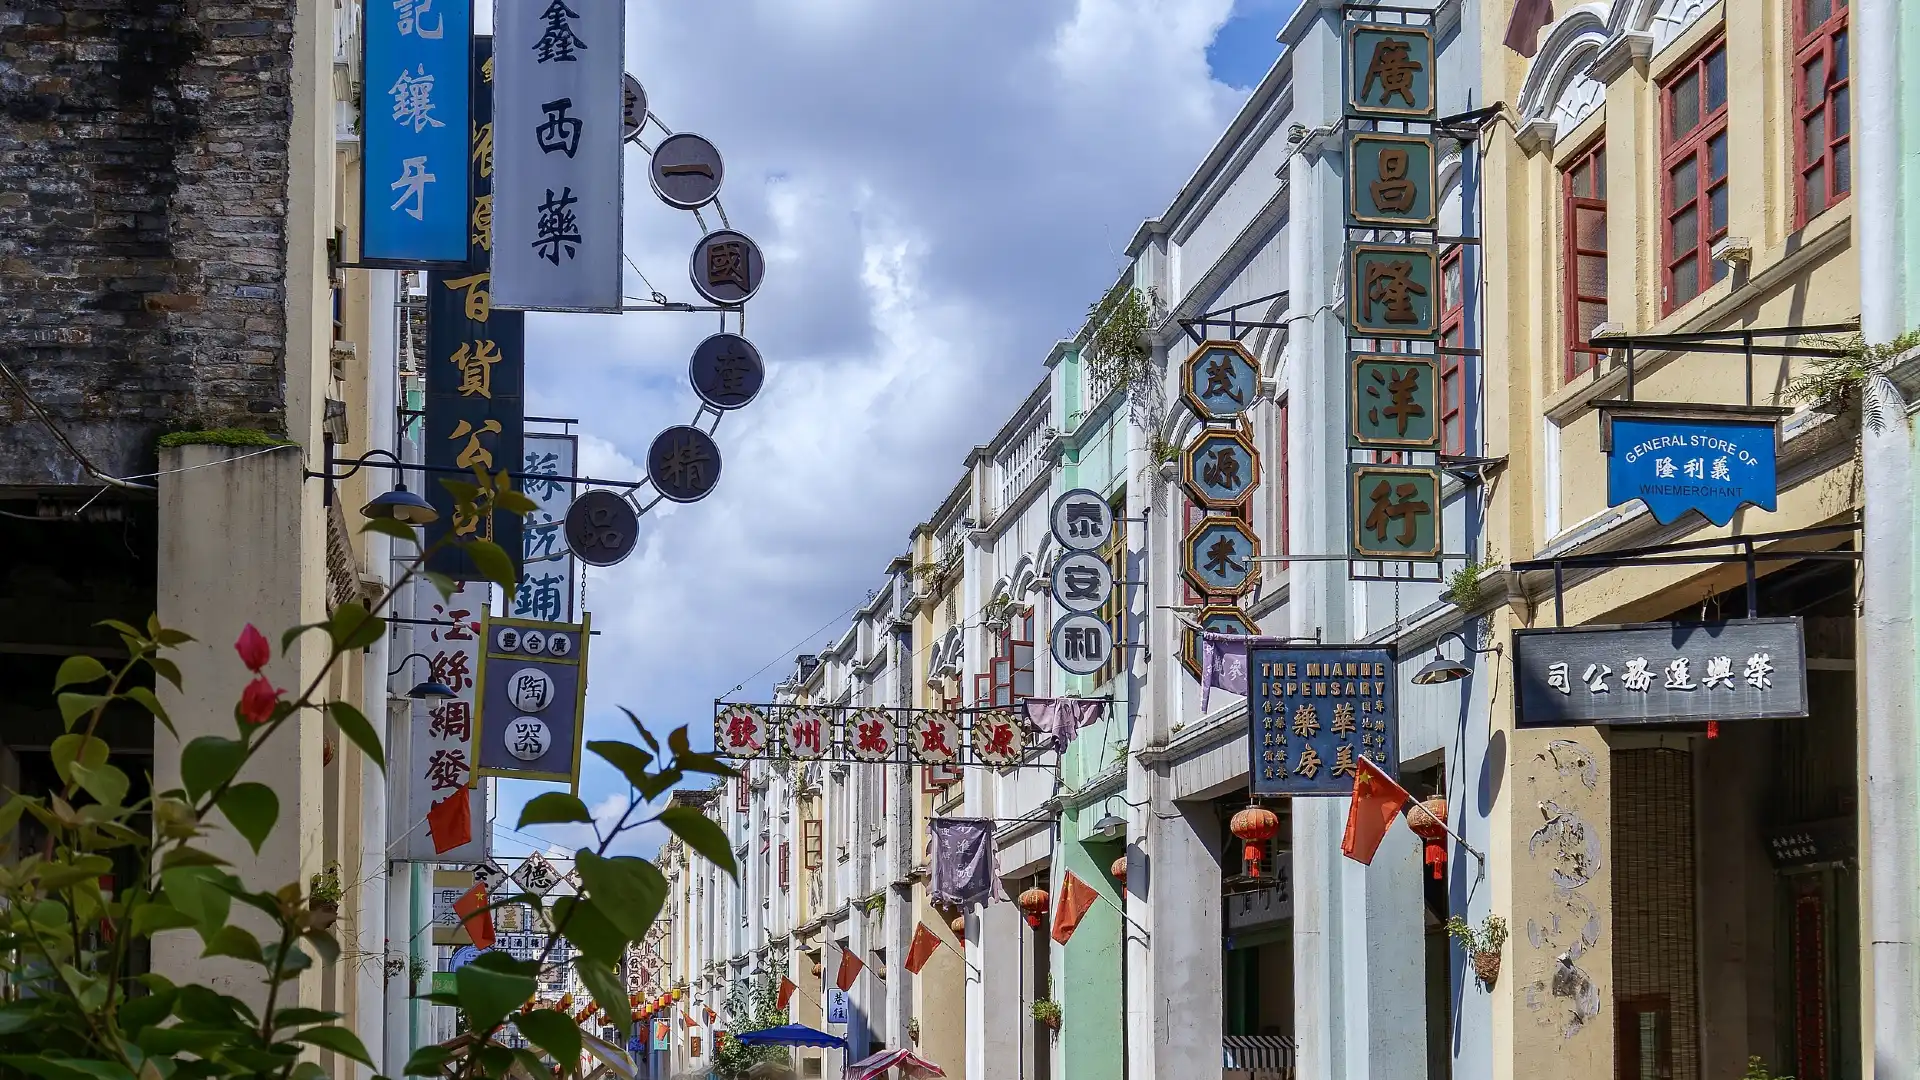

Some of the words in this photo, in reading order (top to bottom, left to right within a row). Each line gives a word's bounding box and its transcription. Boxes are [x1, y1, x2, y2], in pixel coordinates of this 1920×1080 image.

[531, 0, 588, 267] 鑫西藥
[1360, 37, 1431, 547] 廣昌隆洋行
[1625, 435, 1687, 463] GENERAL
[1690, 435, 1737, 456] STORE
[1738, 450, 1758, 467] OF
[1202, 354, 1247, 635] 茂源米
[1639, 484, 1744, 498] WINEMERCHANT
[1063, 502, 1103, 662] 泰安和
[1261, 663, 1297, 677] THE
[1262, 682, 1385, 696] ISPENSARY
[514, 676, 547, 753] 陶器
[726, 715, 1016, 757] 欽州瑞成源
